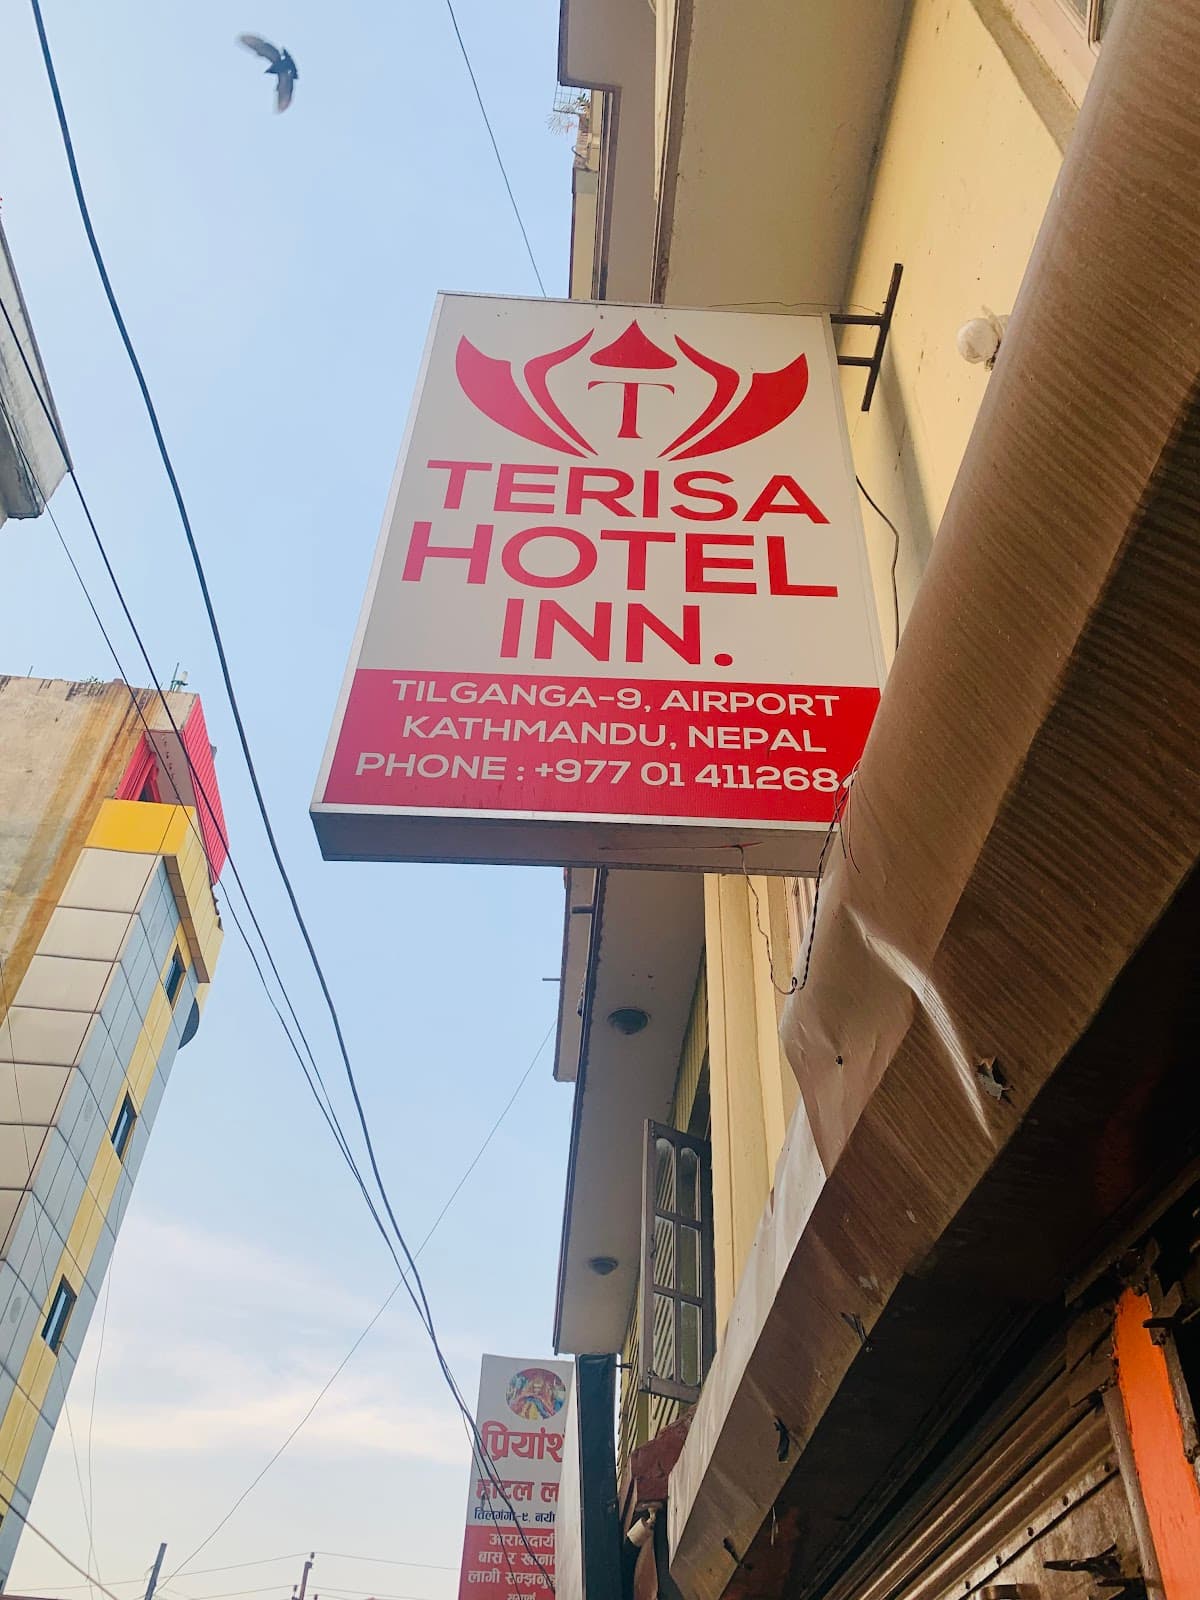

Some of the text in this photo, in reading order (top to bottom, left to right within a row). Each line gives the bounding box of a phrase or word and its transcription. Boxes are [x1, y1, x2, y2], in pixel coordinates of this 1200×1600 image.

[588, 380, 676, 439] T
[427, 459, 832, 525] TERISA
[402, 521, 839, 598] HOTEL
[500, 598, 733, 668] INN.
[392, 679, 840, 717] TILGANGA-9, AIRPORT
[402, 715, 828, 754] KATHMANDU, NEPAL
[355, 751, 506, 781] PHONE
[534, 759, 632, 786] +977
[640, 760, 686, 788] 01
[520, 1552, 556, 1566] खाना
